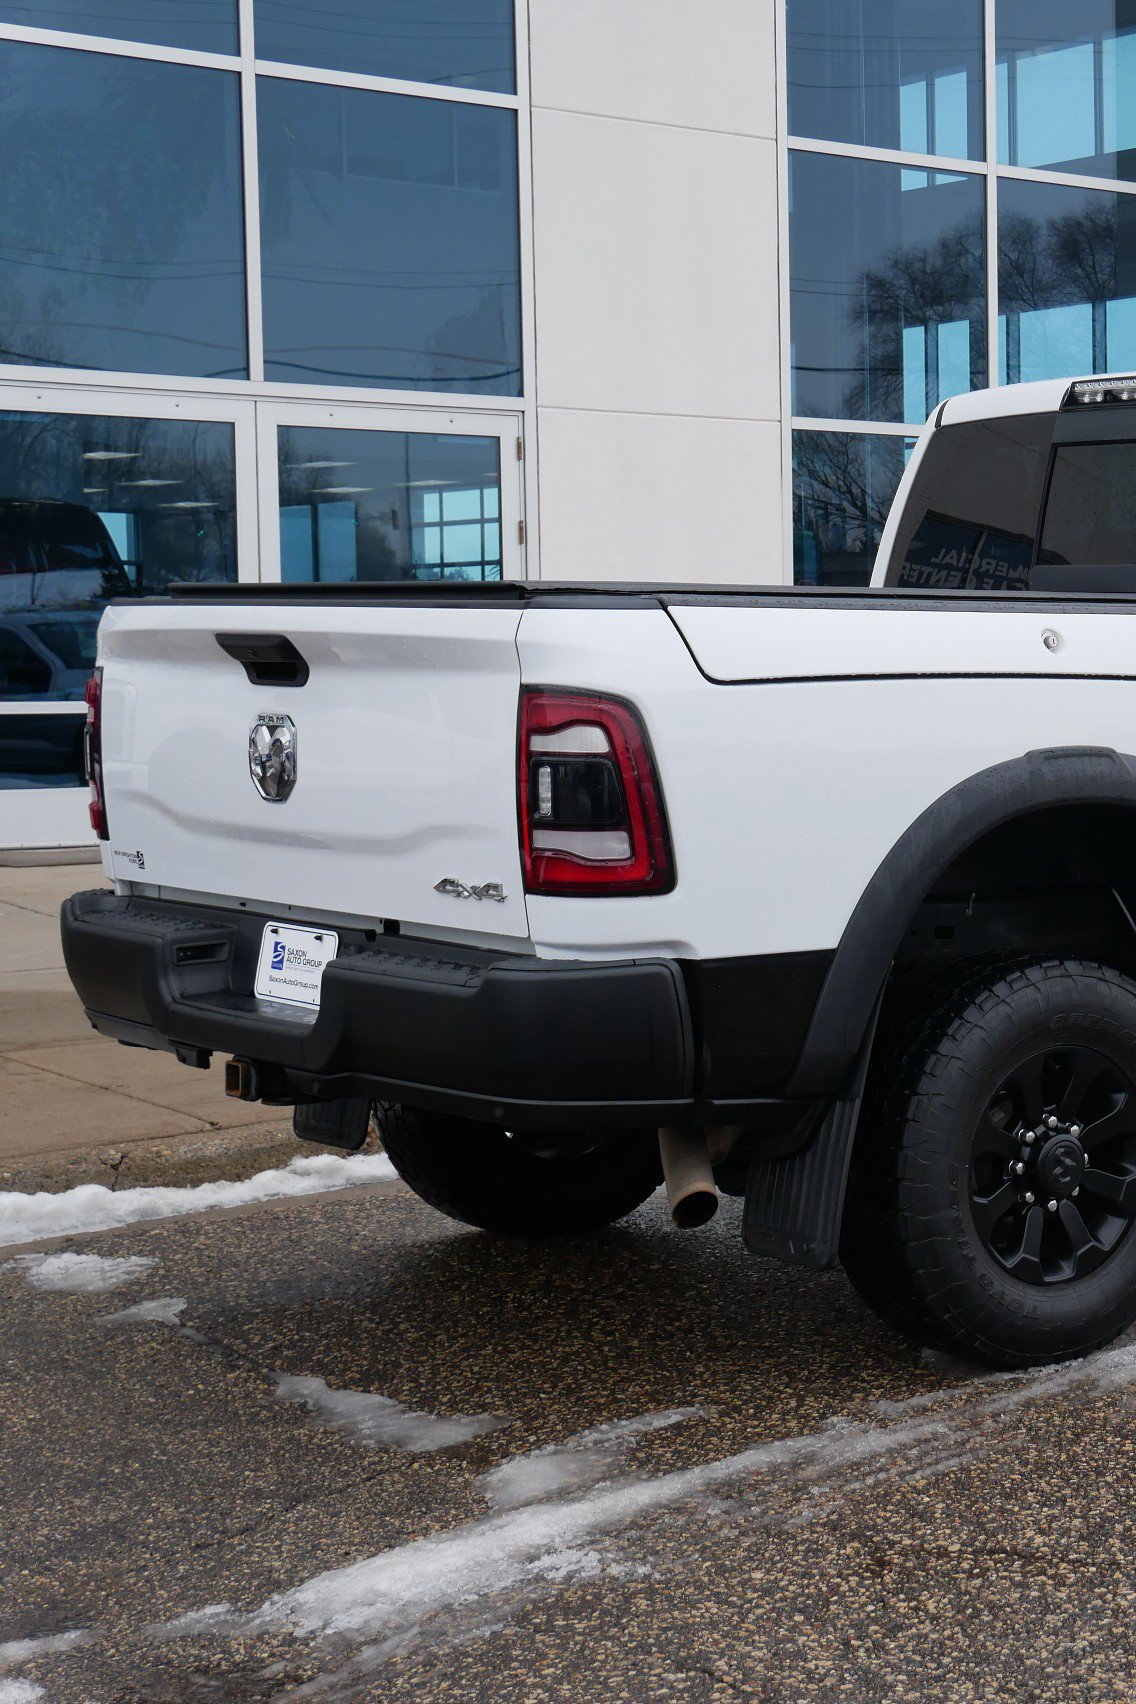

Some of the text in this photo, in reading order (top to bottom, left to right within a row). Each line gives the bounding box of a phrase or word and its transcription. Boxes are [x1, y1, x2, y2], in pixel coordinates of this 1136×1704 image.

[258, 714, 285, 724] RAM
[286, 947, 308, 958] SAXON
[285, 956, 323, 968] AUTO GROUP
[268, 974, 319, 990] SaxonAutoGroup.com
